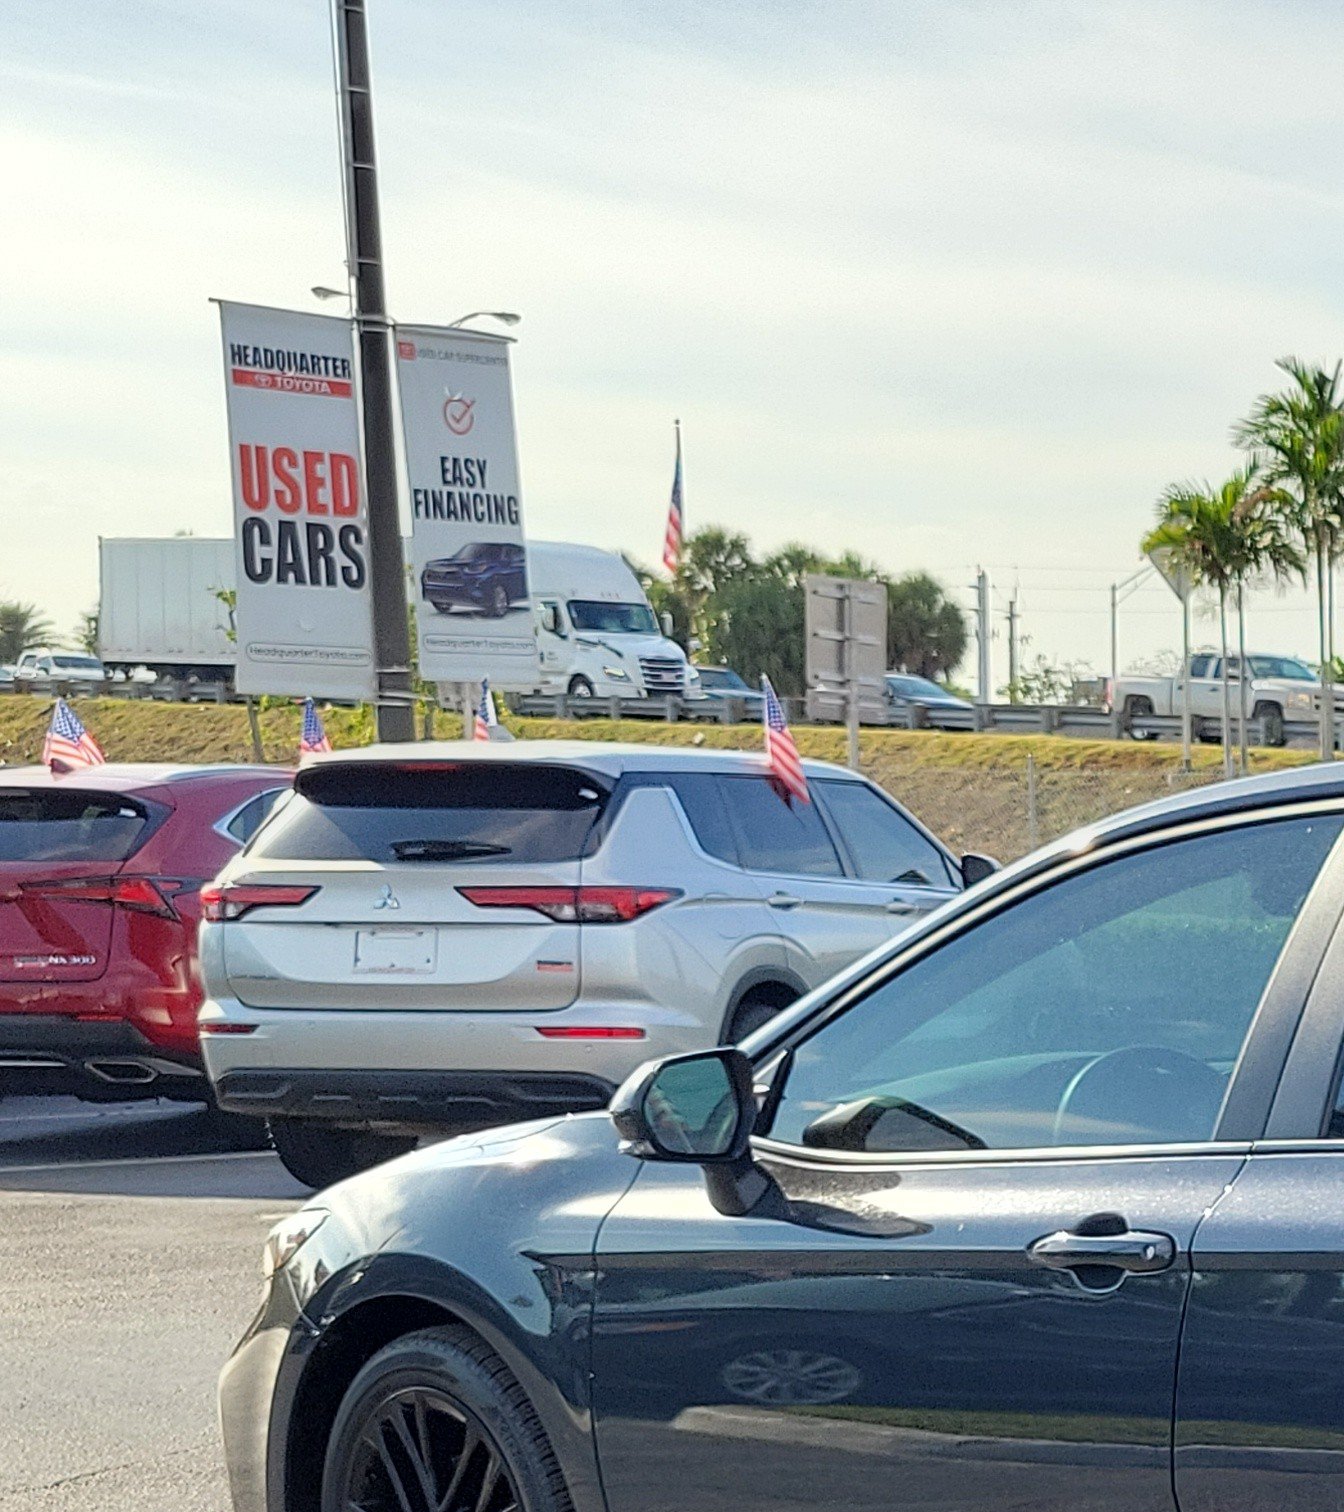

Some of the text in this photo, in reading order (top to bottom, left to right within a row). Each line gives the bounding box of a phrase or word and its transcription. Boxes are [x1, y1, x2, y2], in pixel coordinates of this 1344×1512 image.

[230, 344, 351, 379] HEADQUARTER
[274, 377, 332, 394] TOYOTA
[239, 444, 359, 518] USED
[440, 456, 487, 489] EASY
[414, 489, 519, 526] FINANCING
[242, 517, 366, 590] CARS
